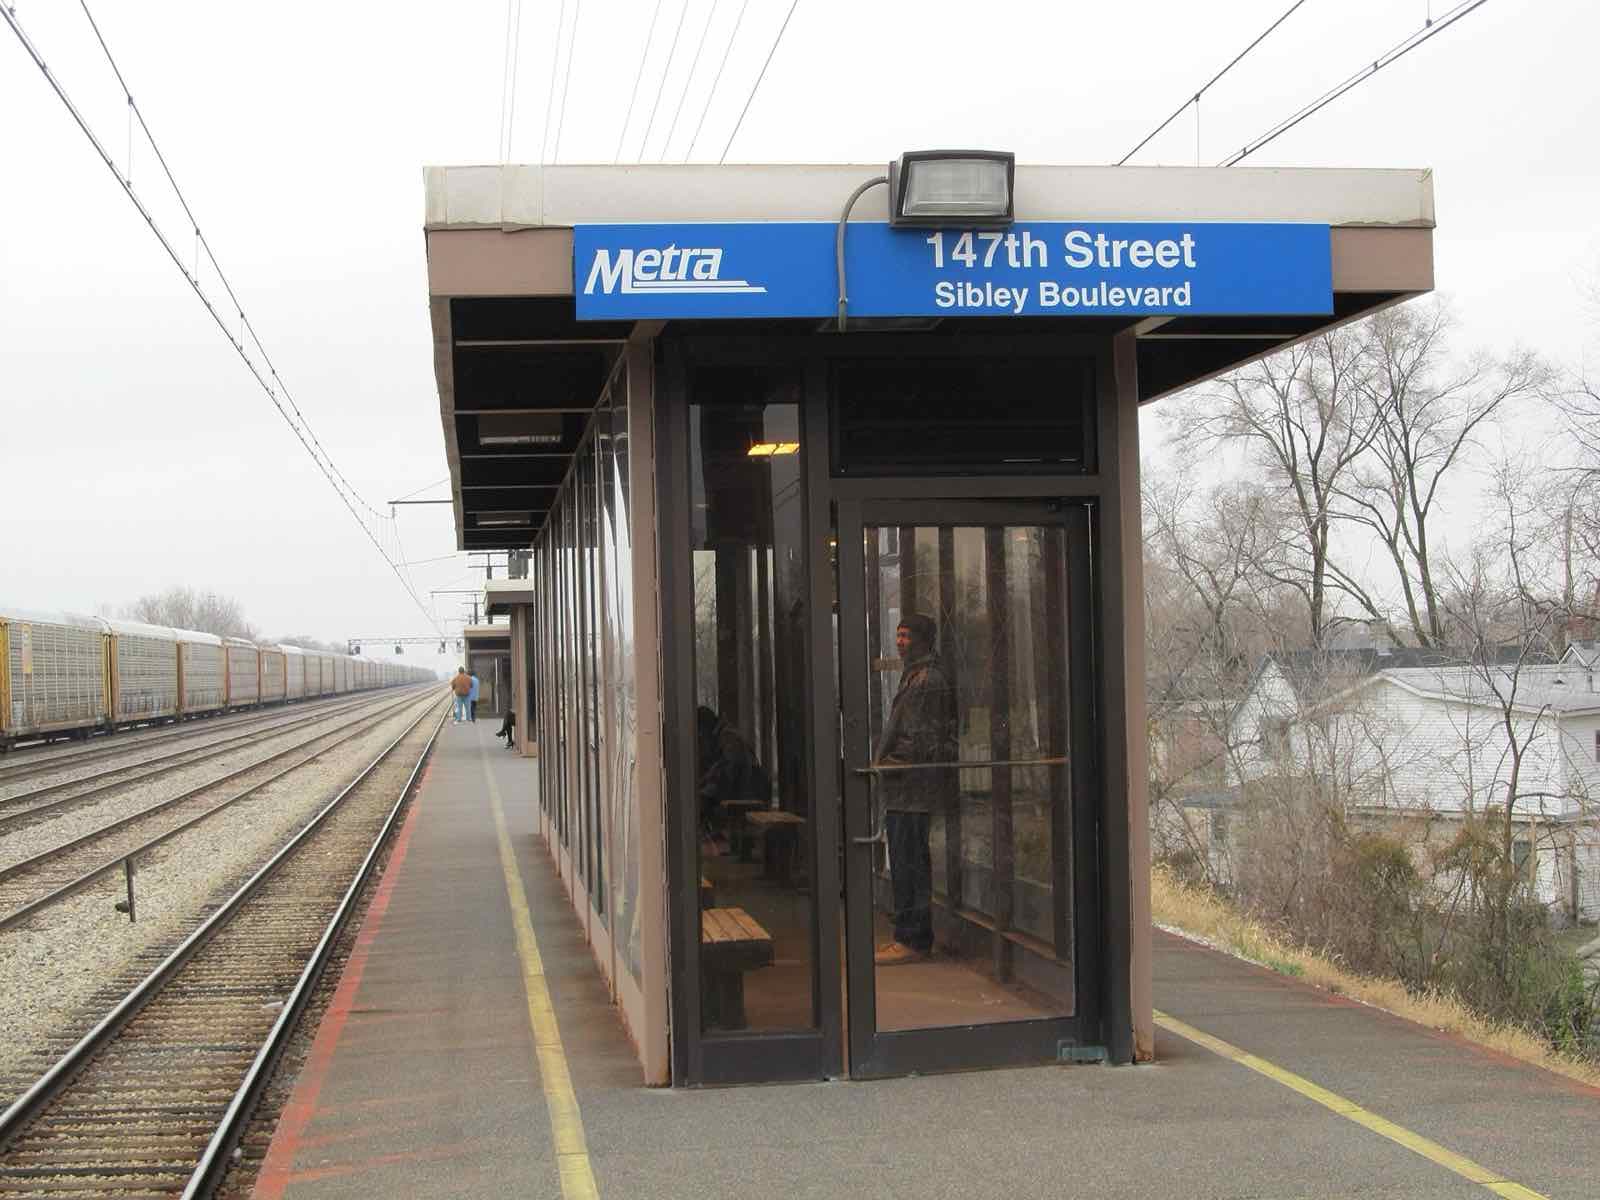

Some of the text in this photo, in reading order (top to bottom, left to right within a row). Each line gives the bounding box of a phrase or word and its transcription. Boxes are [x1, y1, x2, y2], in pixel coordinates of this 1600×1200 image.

[927, 230, 1196, 268] 147th Street
[584, 245, 724, 295] Metra
[935, 281, 1192, 314] Sibley Boulevard
